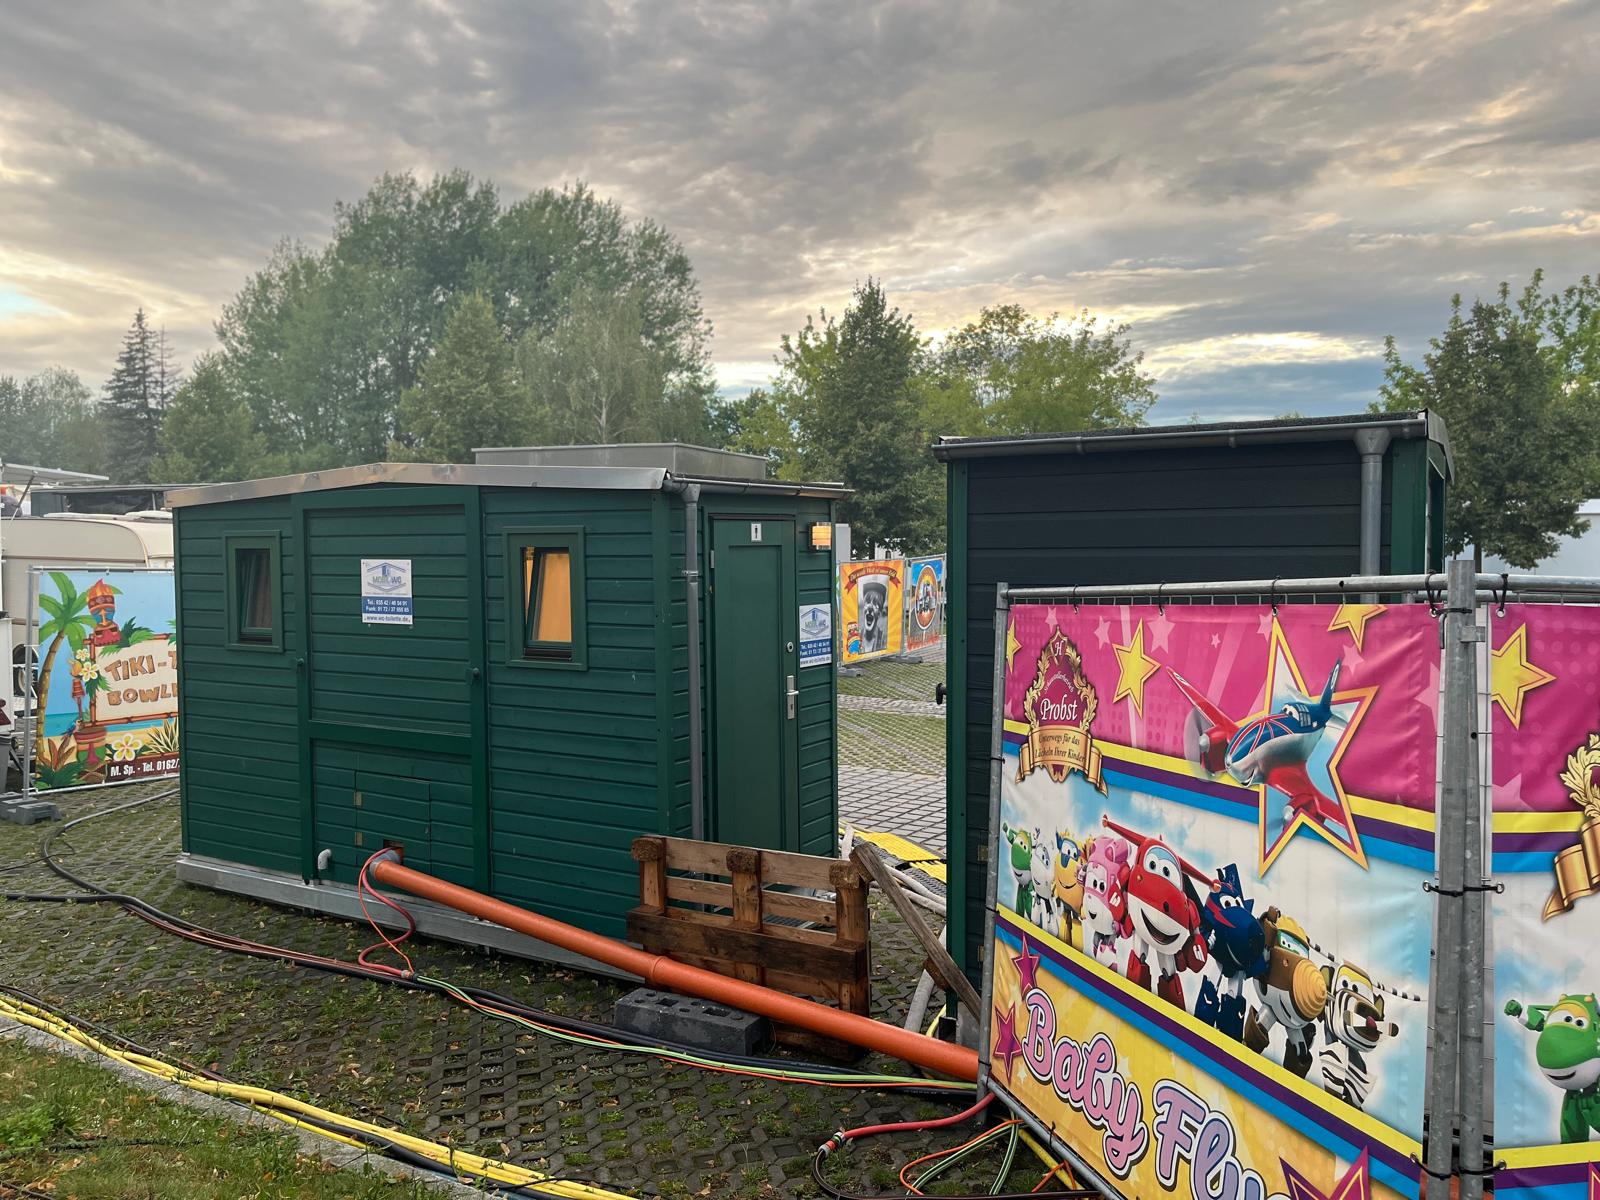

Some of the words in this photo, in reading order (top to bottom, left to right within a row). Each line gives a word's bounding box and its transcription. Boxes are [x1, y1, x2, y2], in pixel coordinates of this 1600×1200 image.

[1054, 640, 1064, 656] H
[1040, 694, 1078, 720] Probst
[1072, 735, 1080, 746] das
[1068, 748, 1086, 763] Kinder
[142, 762, 154, 772] Tel.
[156, 758, 180, 770] 0162/
[1023, 988, 1148, 1176] Baby
